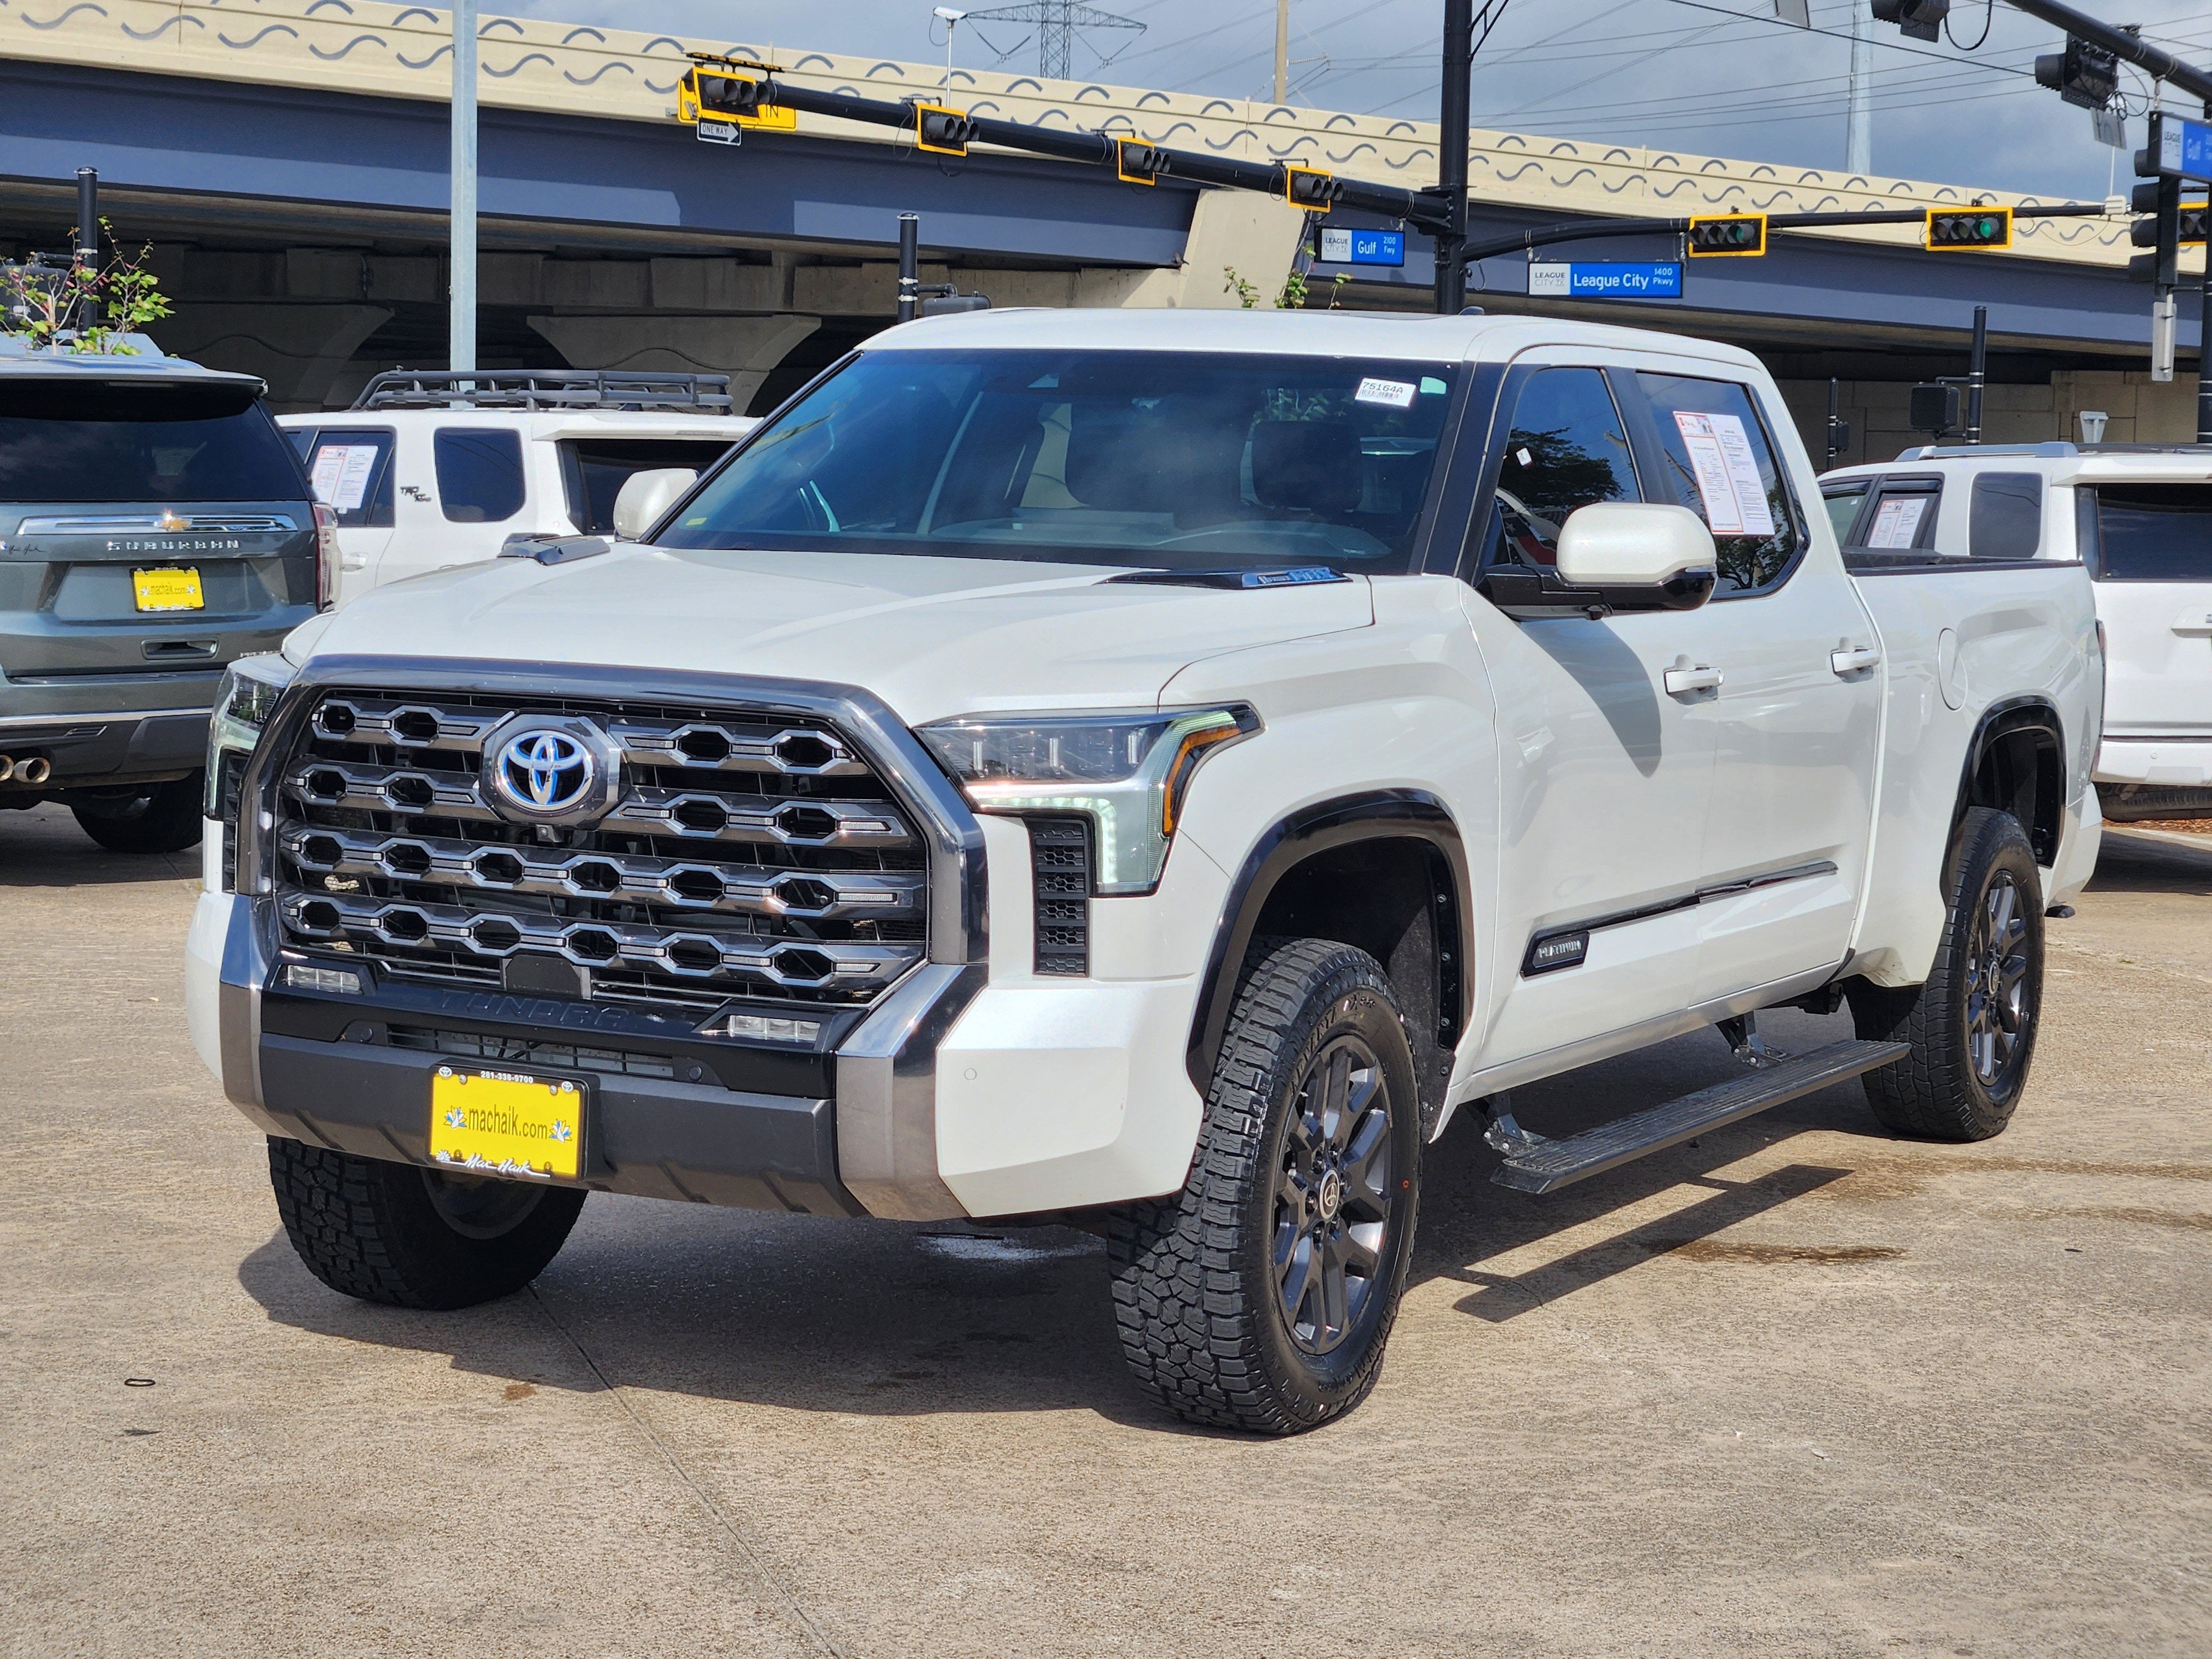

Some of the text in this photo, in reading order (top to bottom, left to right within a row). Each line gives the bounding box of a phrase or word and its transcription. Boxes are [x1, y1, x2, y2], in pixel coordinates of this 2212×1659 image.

[702, 123, 728, 135] ONE WAY
[1383, 236, 1396, 245] 2100
[1358, 240, 1377, 255] Gulf
[1384, 246, 1396, 255] Fwy
[1654, 267, 1673, 276] 1400
[1573, 273, 1650, 291] League City
[1652, 276, 1674, 286] Pkwy
[1363, 382, 1404, 394] 75164A
[107, 540, 239, 551] SUBURBAN
[1538, 940, 1582, 958] PLATINUM
[442, 989, 629, 1026] TUNDRA
[468, 1104, 548, 1140] machaik.com
[465, 1152, 494, 1169] Mac
